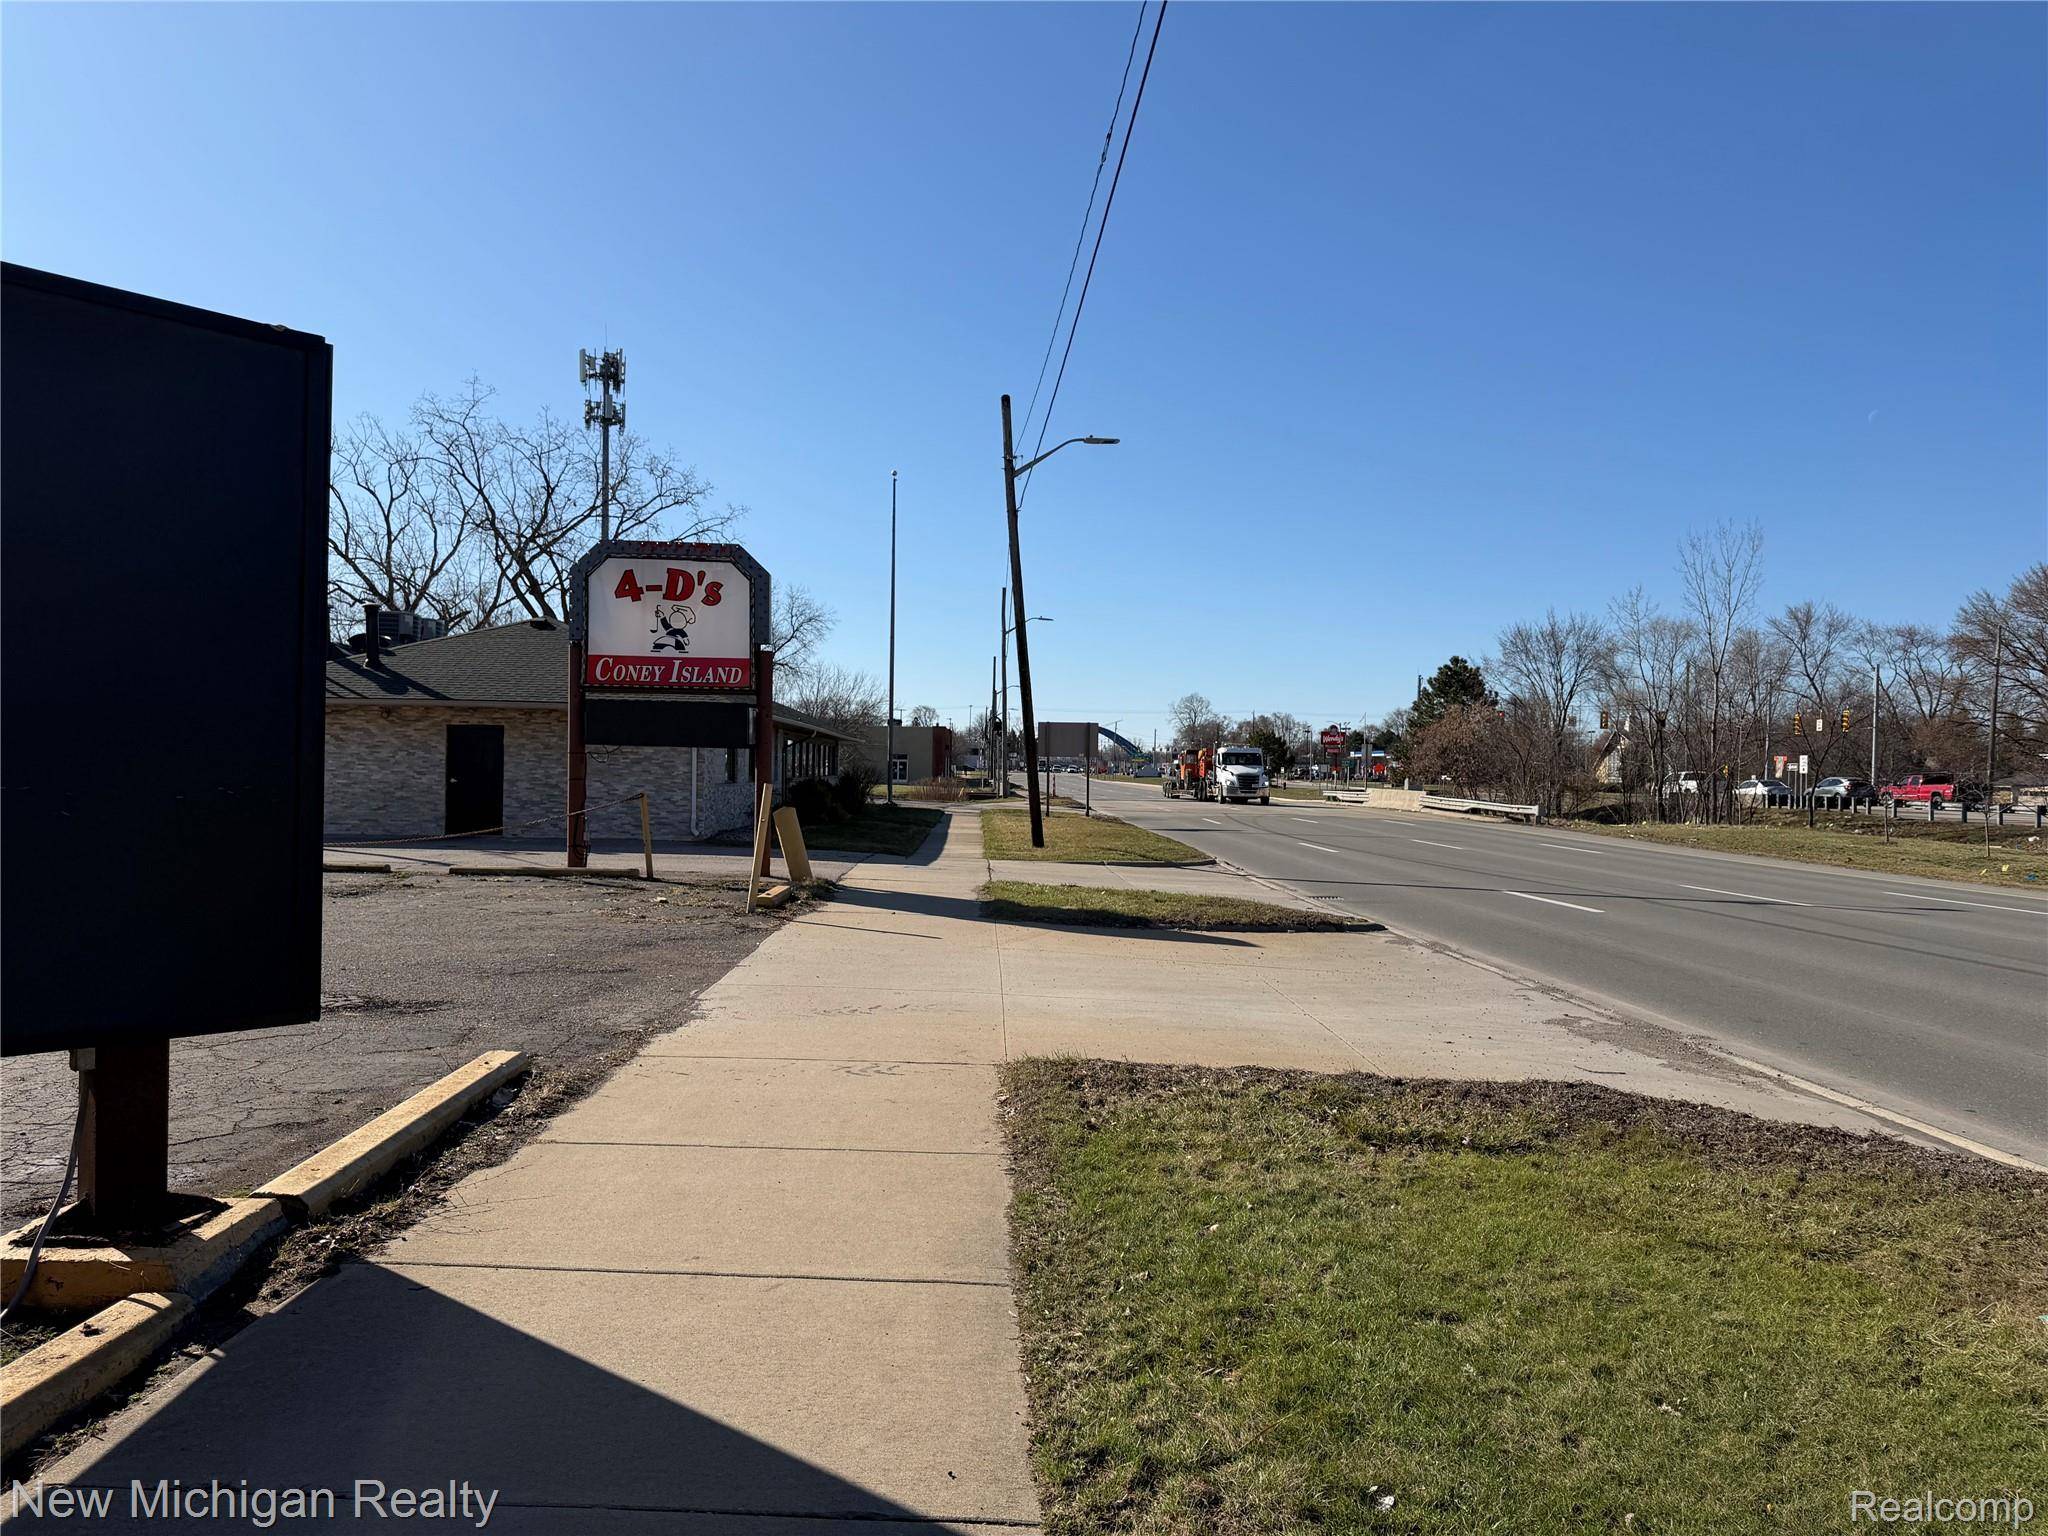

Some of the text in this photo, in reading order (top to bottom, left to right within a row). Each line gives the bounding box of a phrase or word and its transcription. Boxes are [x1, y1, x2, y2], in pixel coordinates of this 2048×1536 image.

[614, 567, 724, 606] 4-D's
[595, 657, 743, 684] CONEY ISLAND
